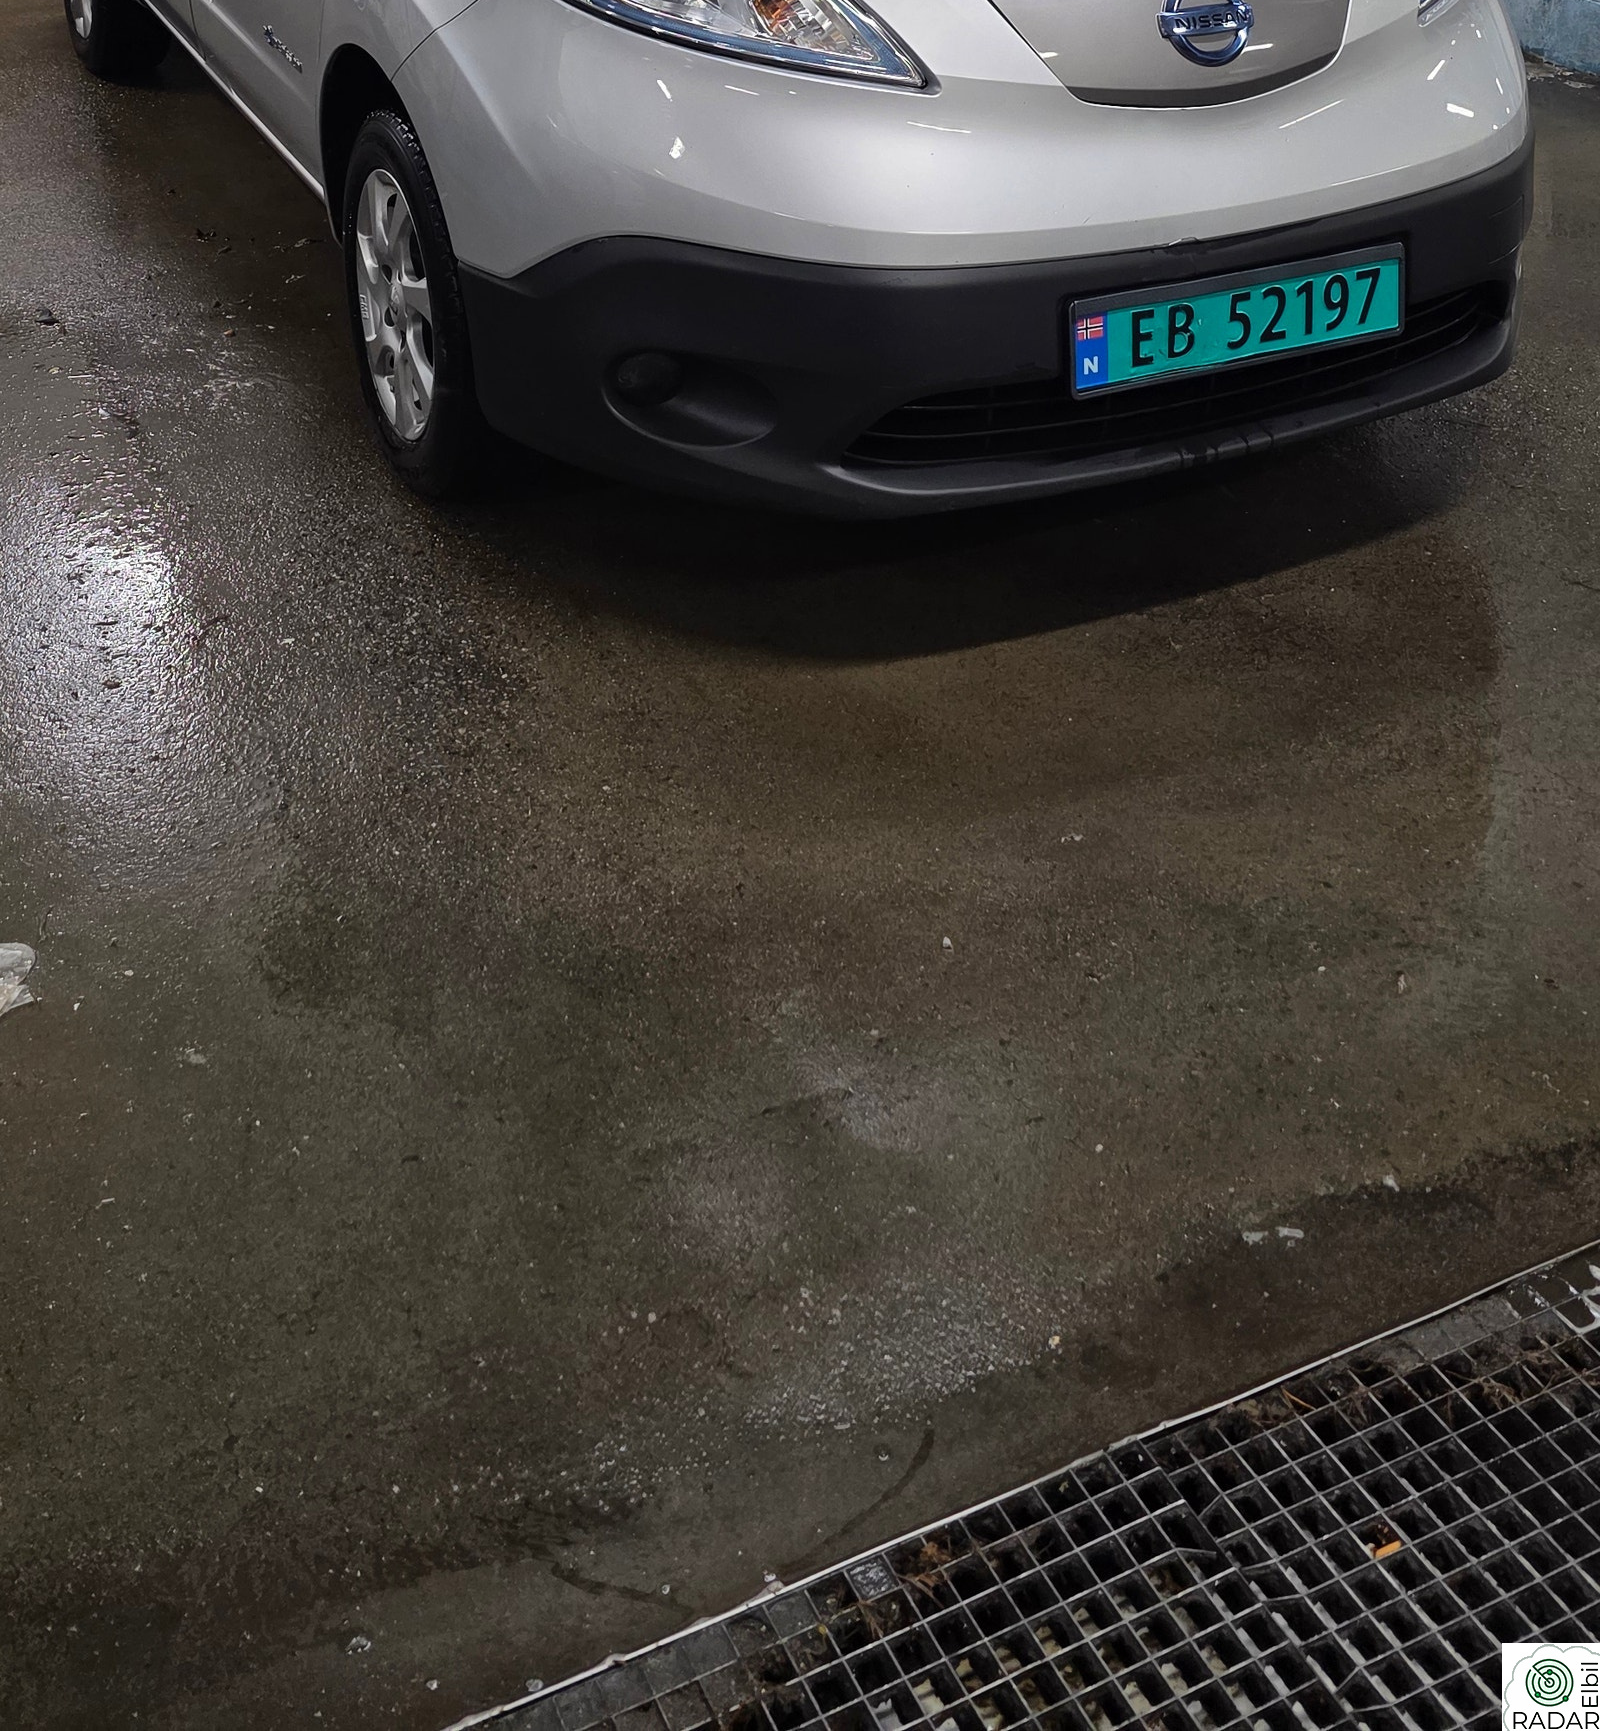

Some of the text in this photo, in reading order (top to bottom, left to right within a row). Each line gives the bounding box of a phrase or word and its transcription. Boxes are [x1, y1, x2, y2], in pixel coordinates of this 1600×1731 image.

[1174, 11, 1247, 29] NISSAN
[1131, 267, 1381, 367] EB 52197
[1083, 357, 1099, 375] N
